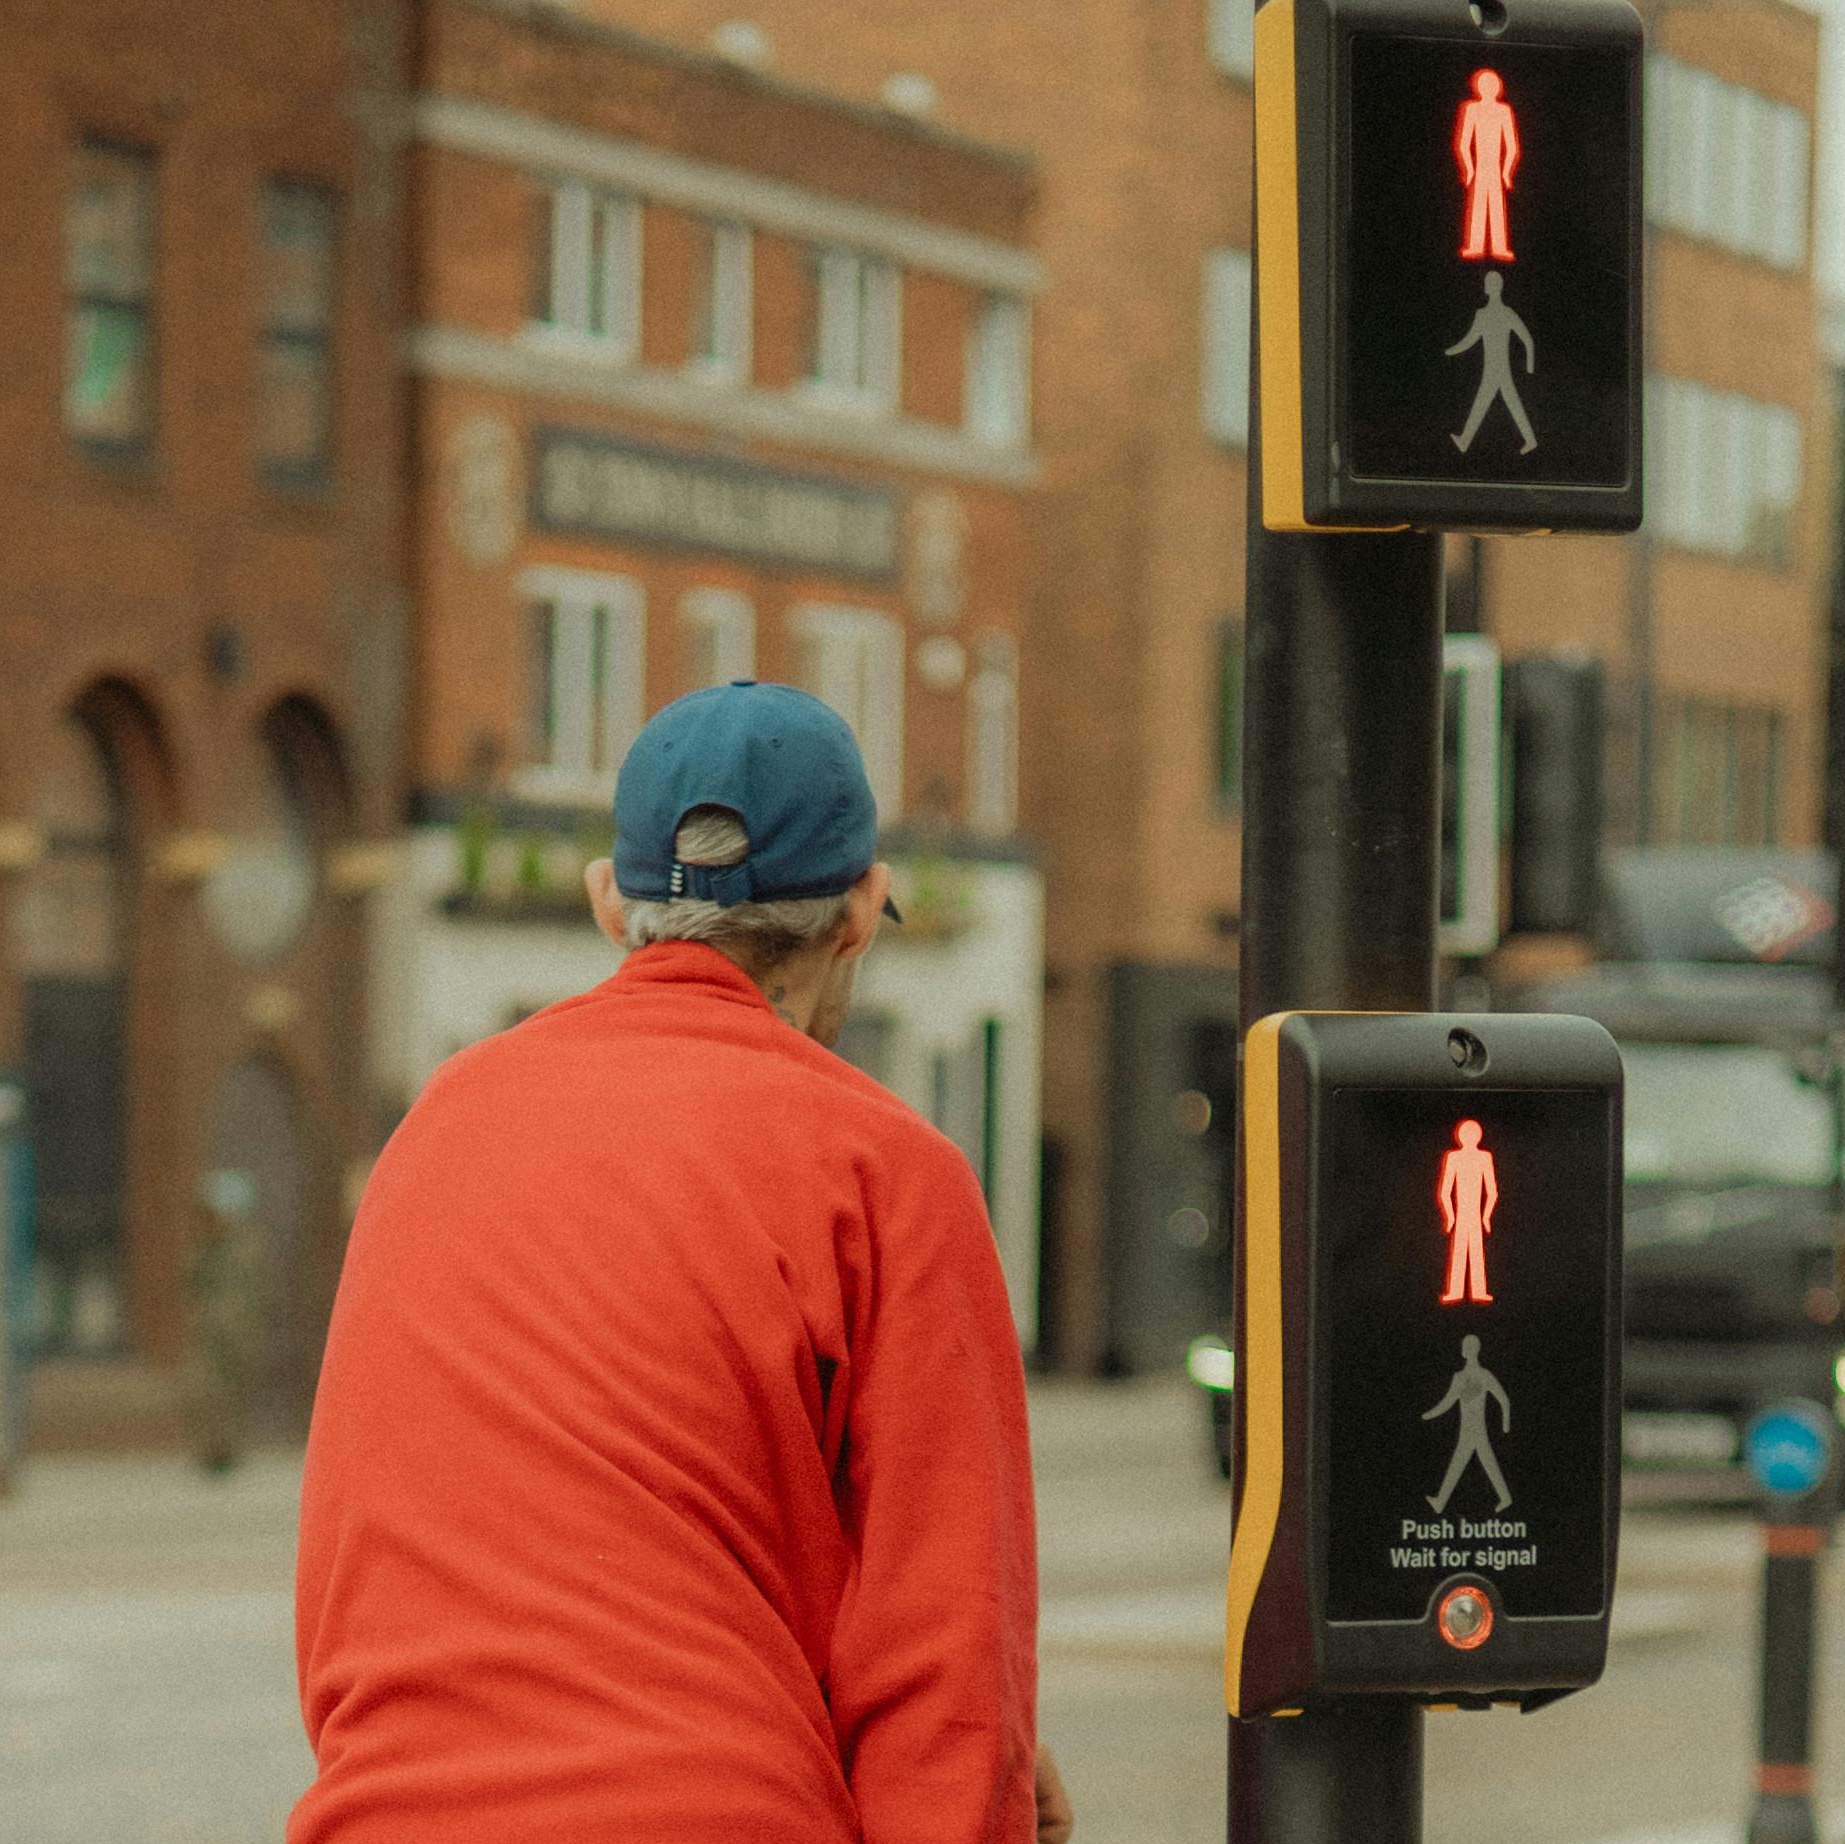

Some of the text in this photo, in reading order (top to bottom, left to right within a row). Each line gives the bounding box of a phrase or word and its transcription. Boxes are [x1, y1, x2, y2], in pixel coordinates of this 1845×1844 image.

[1401, 1518, 1527, 1540] Push button
[1390, 1545, 1537, 1571] Wait for signal
